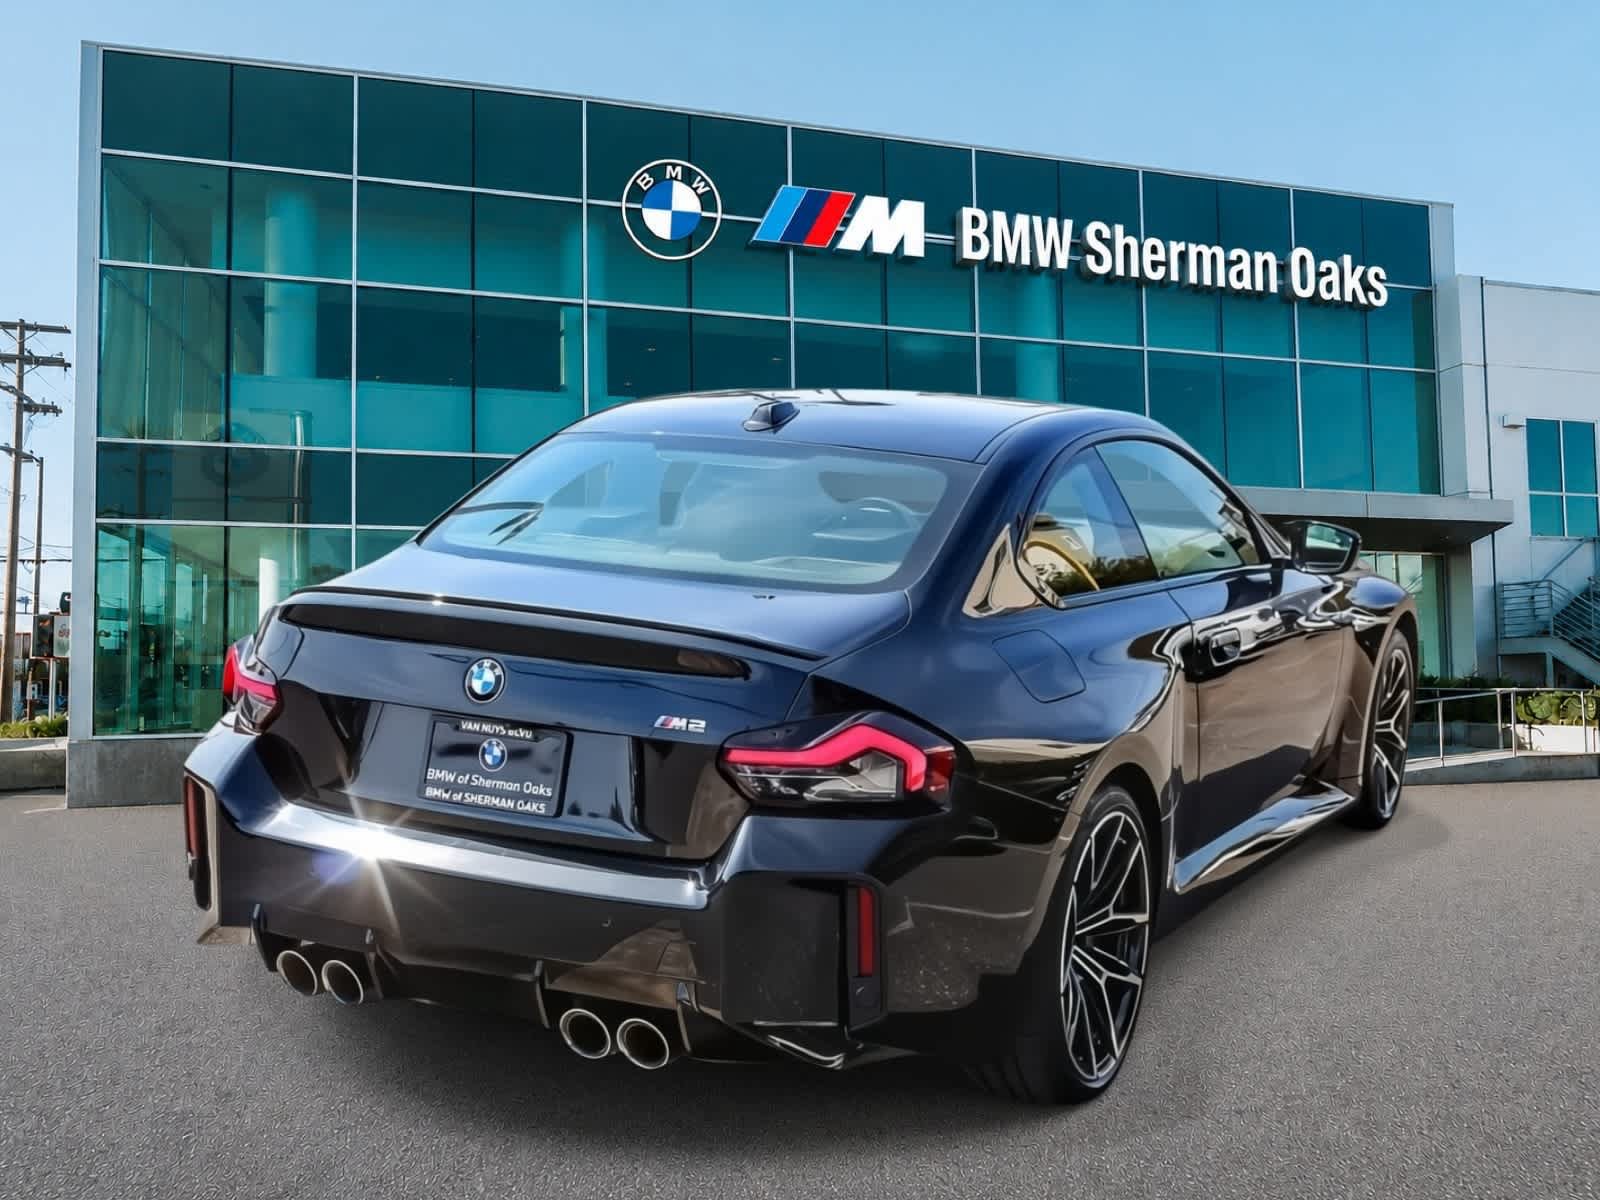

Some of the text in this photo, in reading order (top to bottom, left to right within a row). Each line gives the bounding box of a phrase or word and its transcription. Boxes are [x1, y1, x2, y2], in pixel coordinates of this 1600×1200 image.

[636, 165, 711, 196] BMW
[960, 206, 1389, 308] BMW Sherman Oaks
[461, 720, 480, 731] VAN
[481, 723, 506, 735] NUYS
[427, 768, 553, 797] BMW of Sherman Oaks
[425, 786, 546, 814] BMW of SHERMAN OAKS
